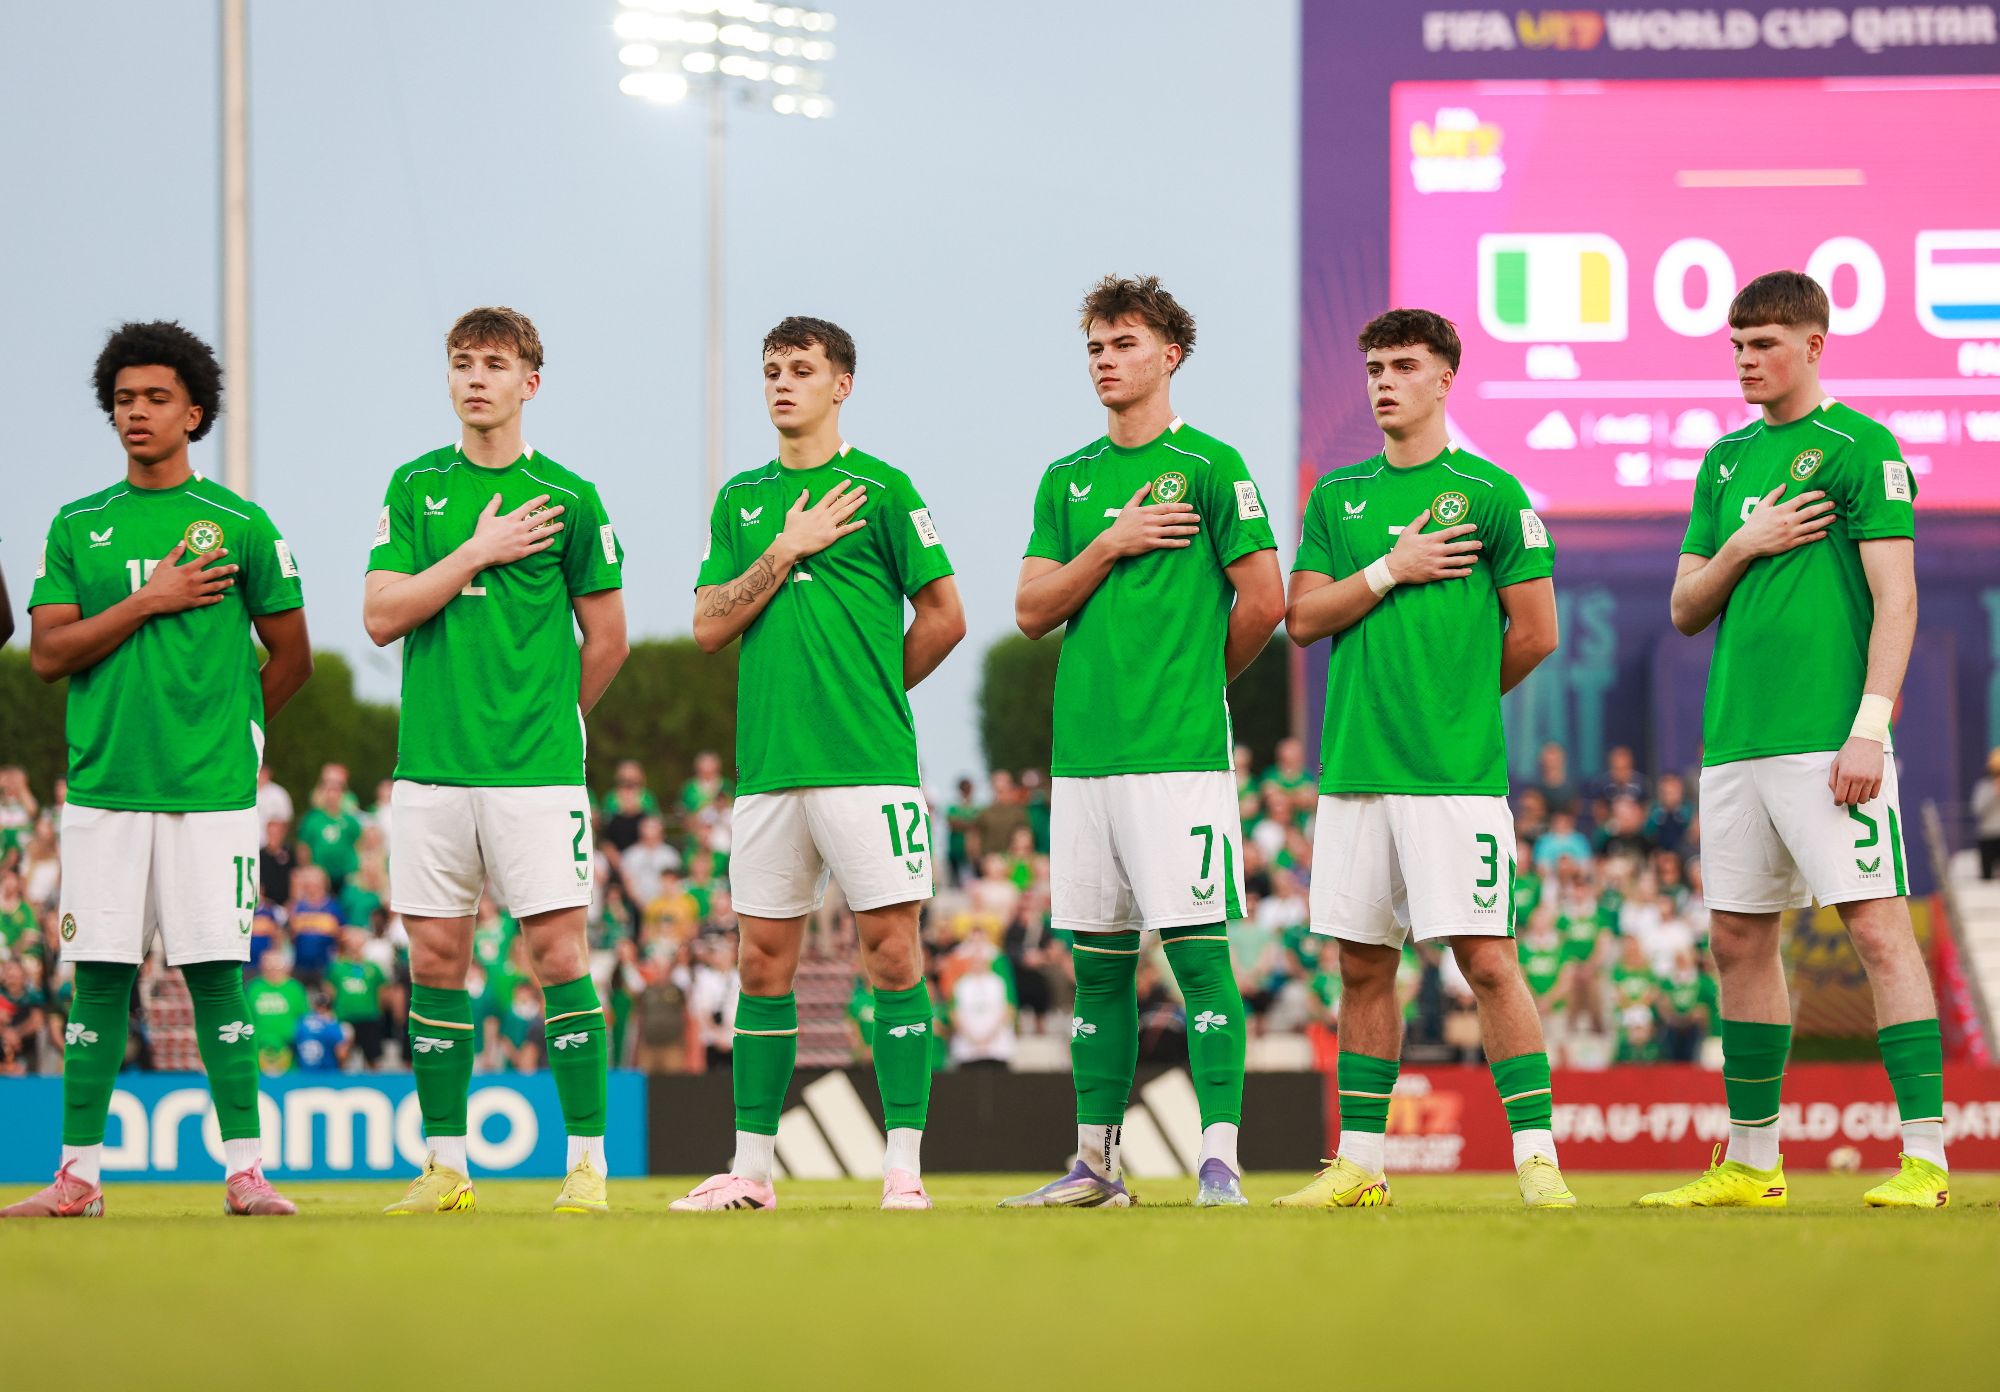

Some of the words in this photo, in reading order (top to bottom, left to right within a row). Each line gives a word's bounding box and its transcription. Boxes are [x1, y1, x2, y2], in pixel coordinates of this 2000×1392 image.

[1423, 10, 1515, 50] FIFA
[1606, 9, 1759, 49] WORLD
[1762, 8, 1849, 48] CUP
[1851, 5, 1997, 53] QATAR
[1654, 237, 1736, 337] 0
[1805, 236, 1886, 336] 0
[569, 810, 588, 861] 2
[881, 801, 925, 857] 12
[1190, 825, 1213, 879] 7
[233, 856, 258, 910] 15
[1475, 833, 1498, 887] 3
[1692, 1102, 1840, 1141] WLD
[1842, 1102, 1903, 1141] CU
